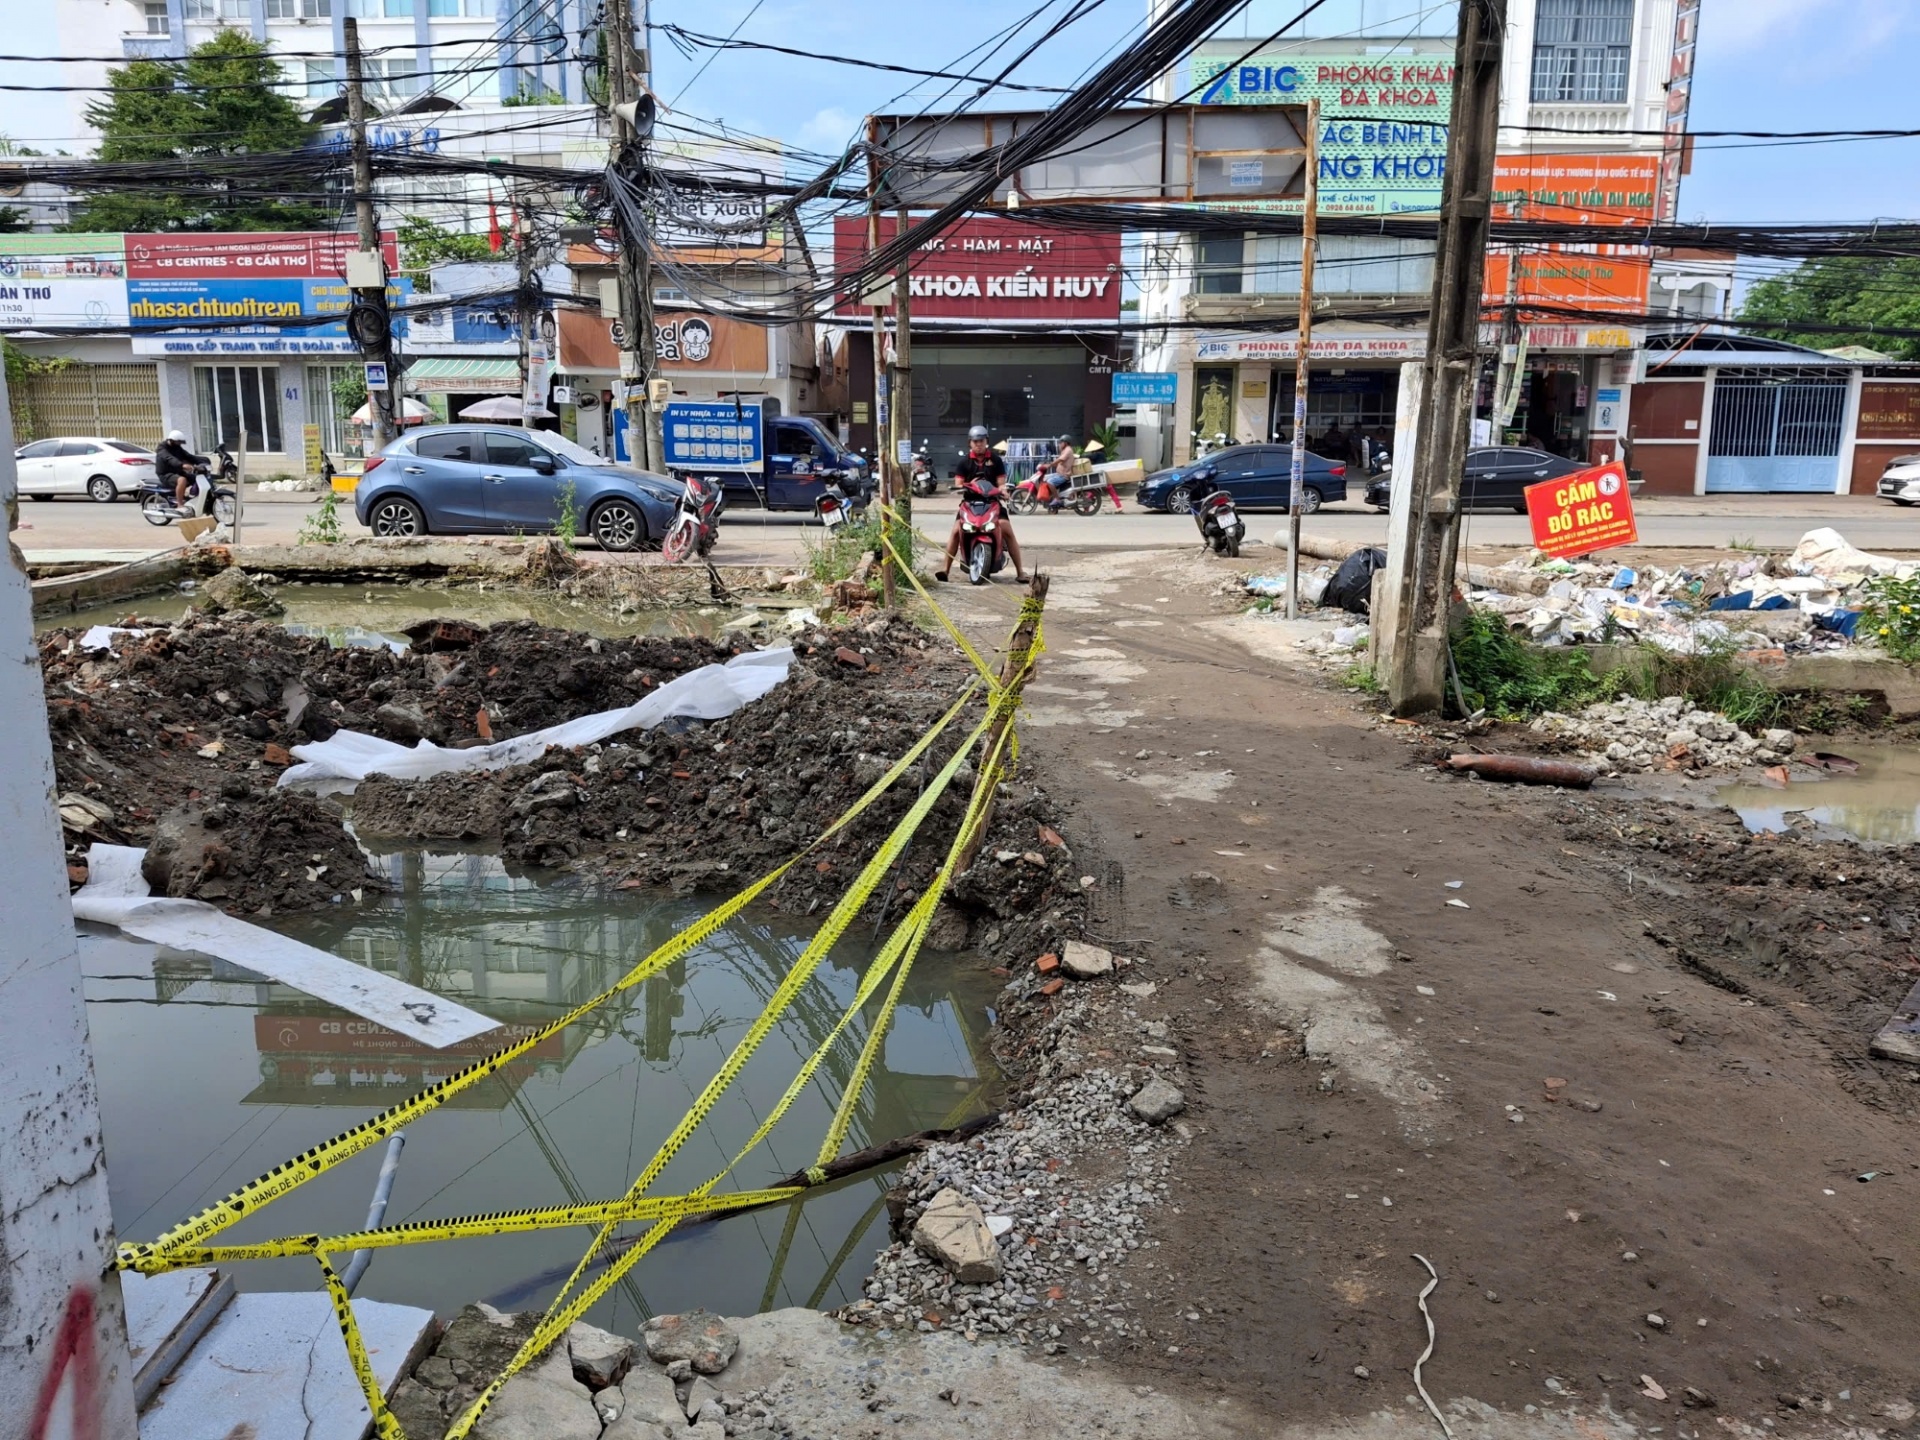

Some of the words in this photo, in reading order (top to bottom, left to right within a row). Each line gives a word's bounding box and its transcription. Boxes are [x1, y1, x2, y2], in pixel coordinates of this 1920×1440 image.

[1239, 67, 1297, 92] BIC
[1317, 61, 1394, 83] PHÒNG
[1340, 88, 1370, 106] ĐA
[1378, 88, 1438, 106] KHOA
[1362, 121, 1423, 147] BỆNH
[1627, 191, 1654, 210] HỌC
[1018, 235, 1054, 257] MẶT
[175, 256, 227, 267] CENTRES
[236, 256, 251, 266] CB
[282, 254, 307, 265] THƠ
[908, 275, 981, 297] KHOA
[987, 265, 1048, 297] KIẾN
[1053, 276, 1111, 297] HUY
[23, 285, 51, 299] THƠ
[130, 297, 301, 318] nhasachtuoitre.vn
[1210, 343, 1228, 351] BIC
[1238, 340, 1289, 351] PHÒNG
[1343, 342, 1363, 350] ĐA
[1368, 341, 1408, 350] KHOA
[1090, 354, 1108, 365] 47
[1089, 366, 1112, 374] CMT8
[285, 387, 298, 400] 41
[1555, 479, 1598, 507] CẤM
[1547, 505, 1573, 534] ĐỔ
[1576, 502, 1614, 527] RÁC
[326, 1147, 350, 1166] HÀNG
[251, 1186, 279, 1206] HÀNG
[162, 1231, 194, 1254] HÀNG
